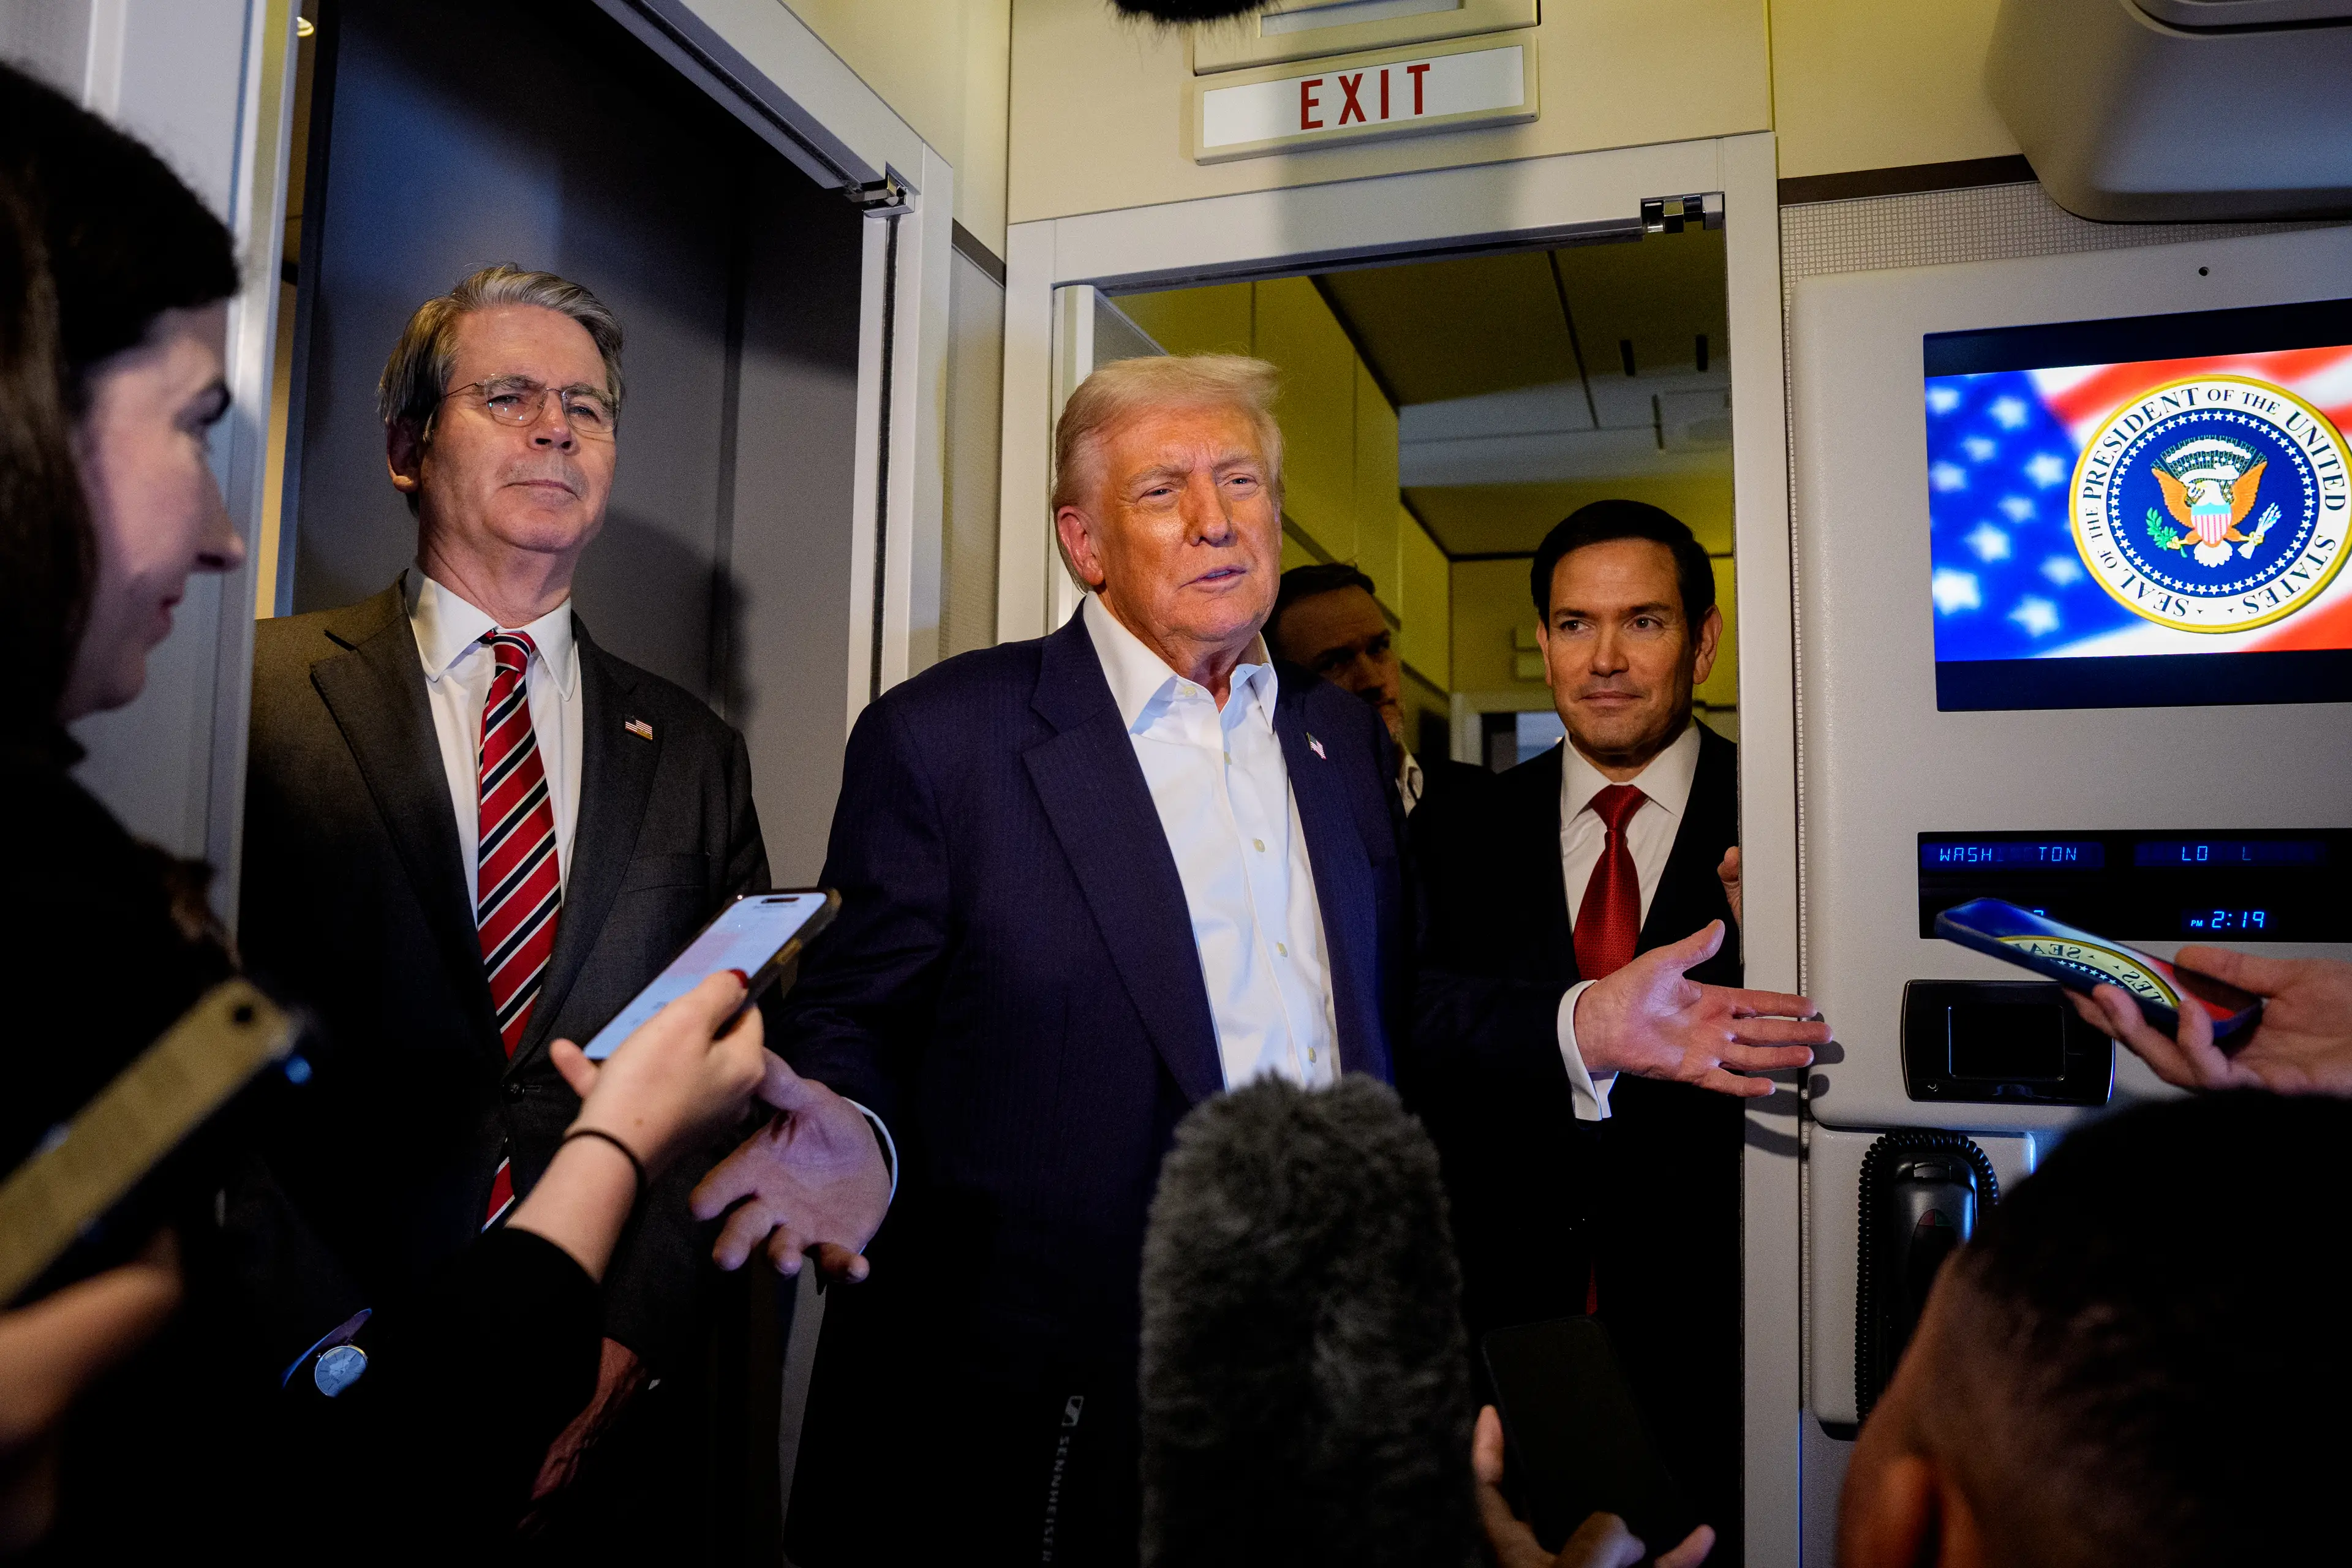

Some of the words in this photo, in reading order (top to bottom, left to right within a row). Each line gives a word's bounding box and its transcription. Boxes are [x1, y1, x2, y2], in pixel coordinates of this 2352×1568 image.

[1300, 64, 1430, 130] EXIT
[2207, 389, 2236, 402] OF
[2242, 391, 2280, 416] THE
[2083, 387, 2199, 500] PRESIDENT
[2286, 410, 2346, 511] UNITED
[2084, 506, 2104, 543] THE
[2097, 549, 2118, 569] OF
[2242, 535, 2337, 615] STATES
[2121, 568, 2190, 617] SEAL
[2211, 910, 2265, 929] 2:19
